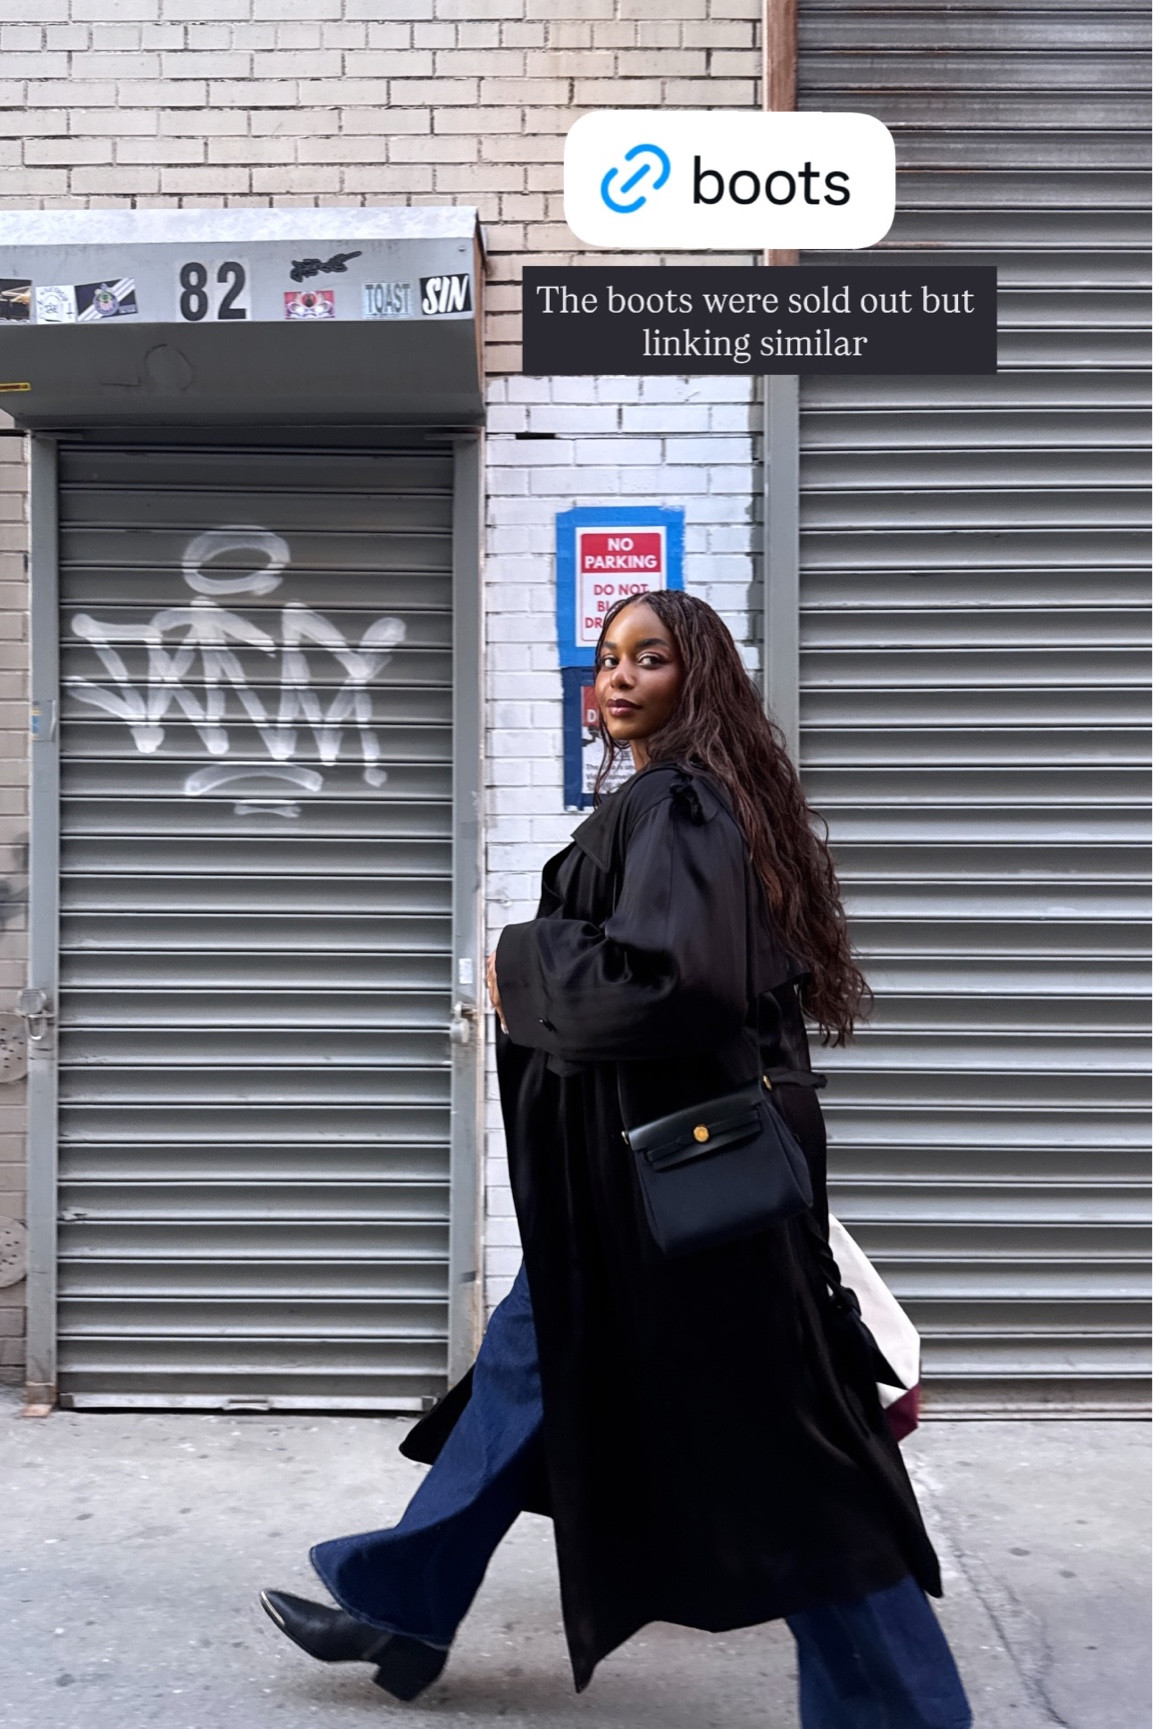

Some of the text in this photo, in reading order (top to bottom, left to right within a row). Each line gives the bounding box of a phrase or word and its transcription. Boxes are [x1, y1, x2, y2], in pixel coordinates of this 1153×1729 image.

[179, 261, 247, 322] 82
[364, 283, 411, 314] TOAST
[422, 274, 470, 315] SIN
[607, 538, 634, 552] NO
[584, 554, 658, 569] PARKING
[594, 584, 615, 596] DO
